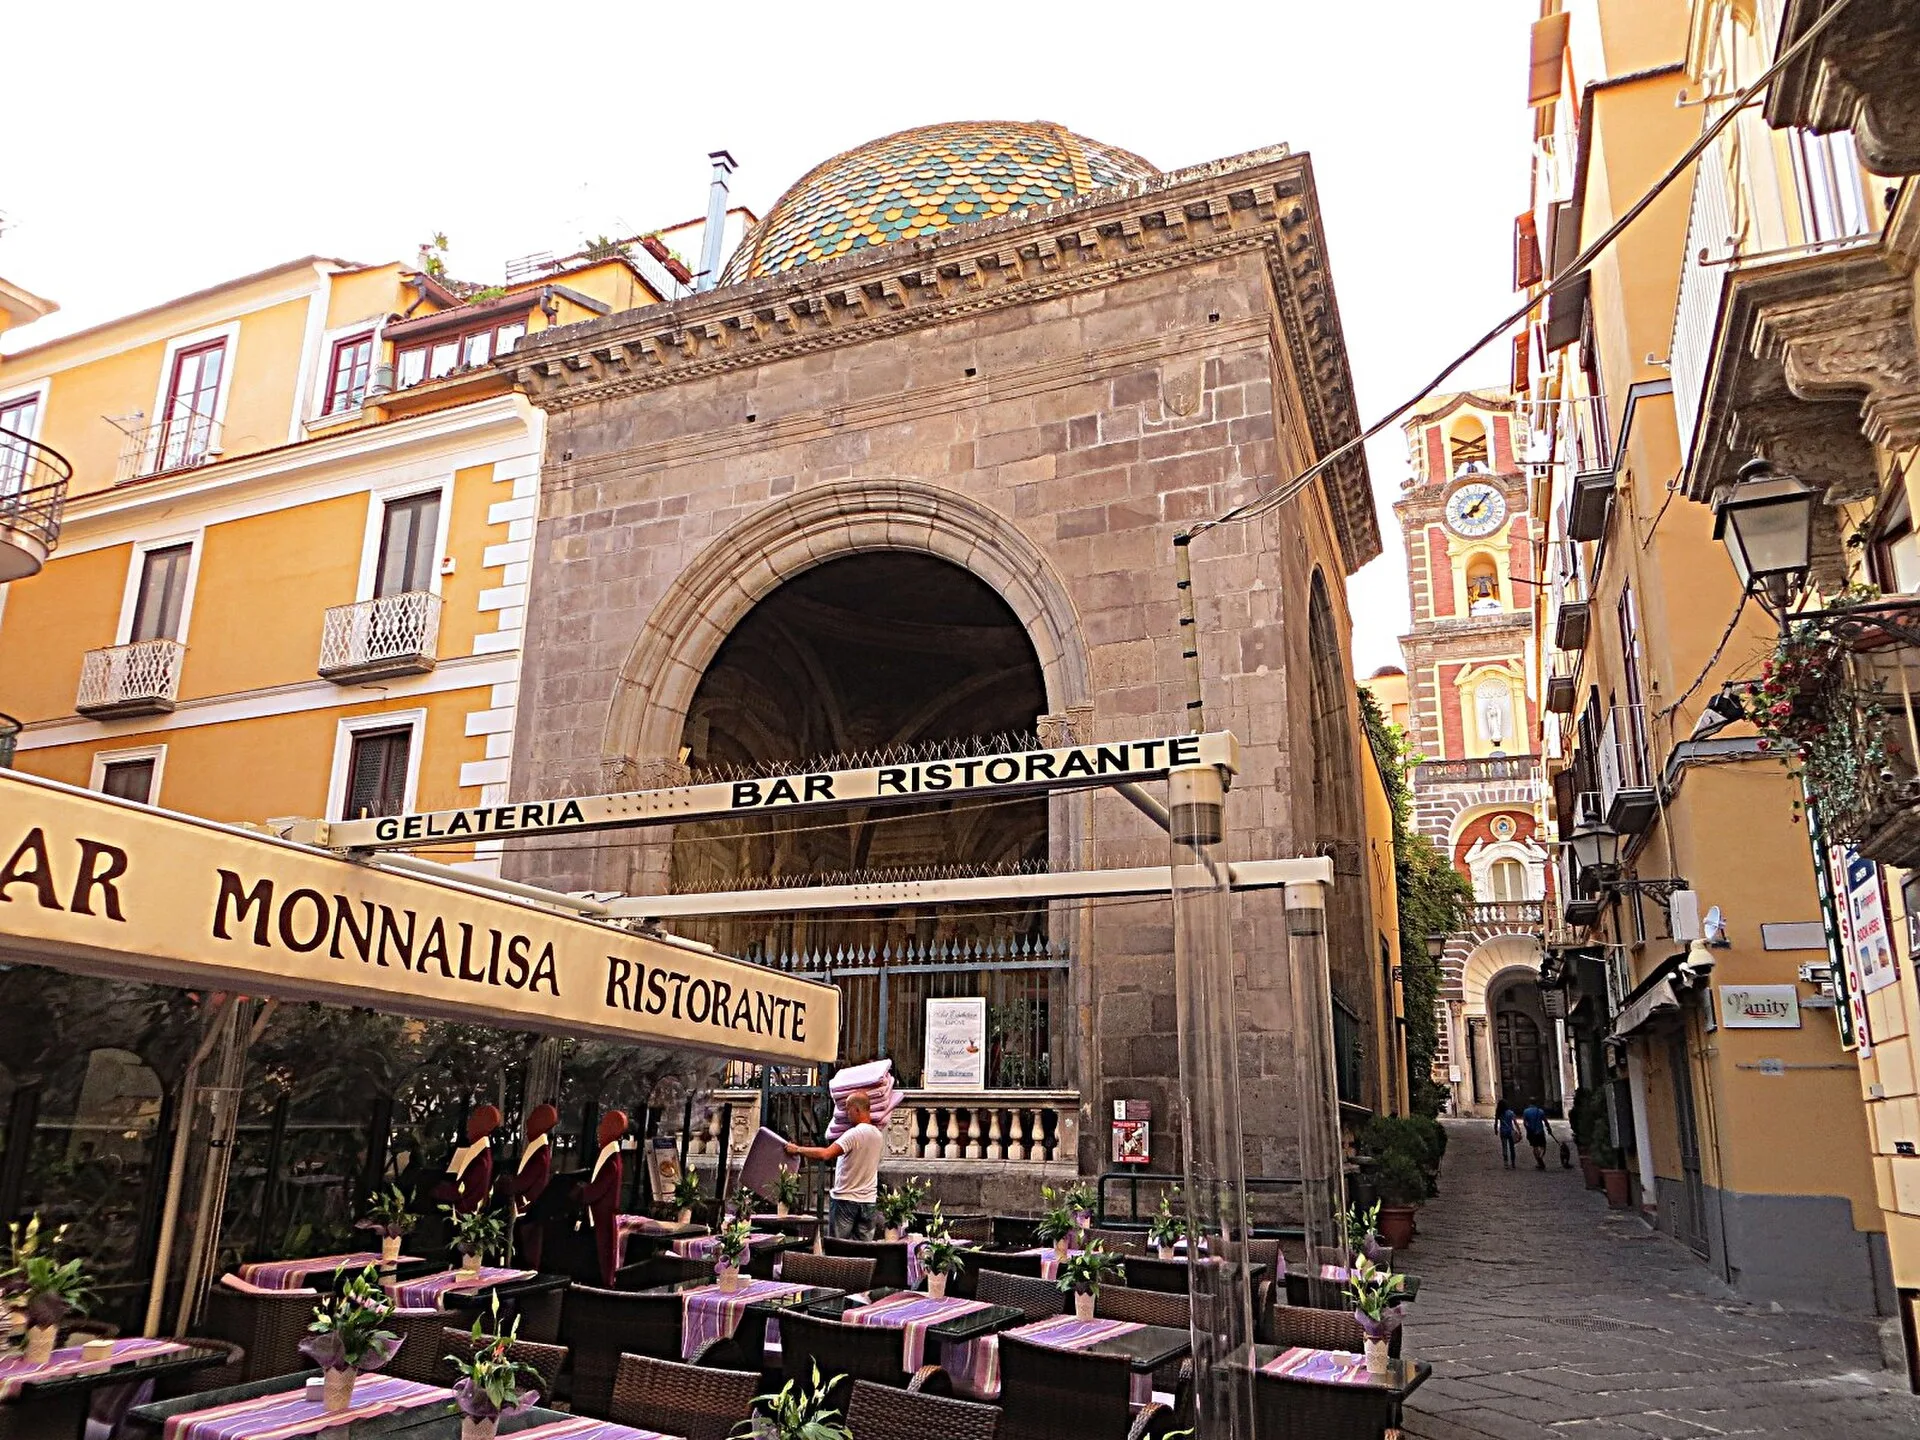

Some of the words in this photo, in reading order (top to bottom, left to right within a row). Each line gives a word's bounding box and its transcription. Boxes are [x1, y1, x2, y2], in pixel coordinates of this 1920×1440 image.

[375, 800, 585, 841] GELATERIA
[732, 774, 834, 808] BAR
[878, 737, 1201, 794] RISTORANTE
[0, 827, 128, 923] AR
[212, 868, 561, 998] MONNALISA
[605, 956, 807, 1043] RISTORANTE
[1727, 991, 1790, 1018] Vanity
